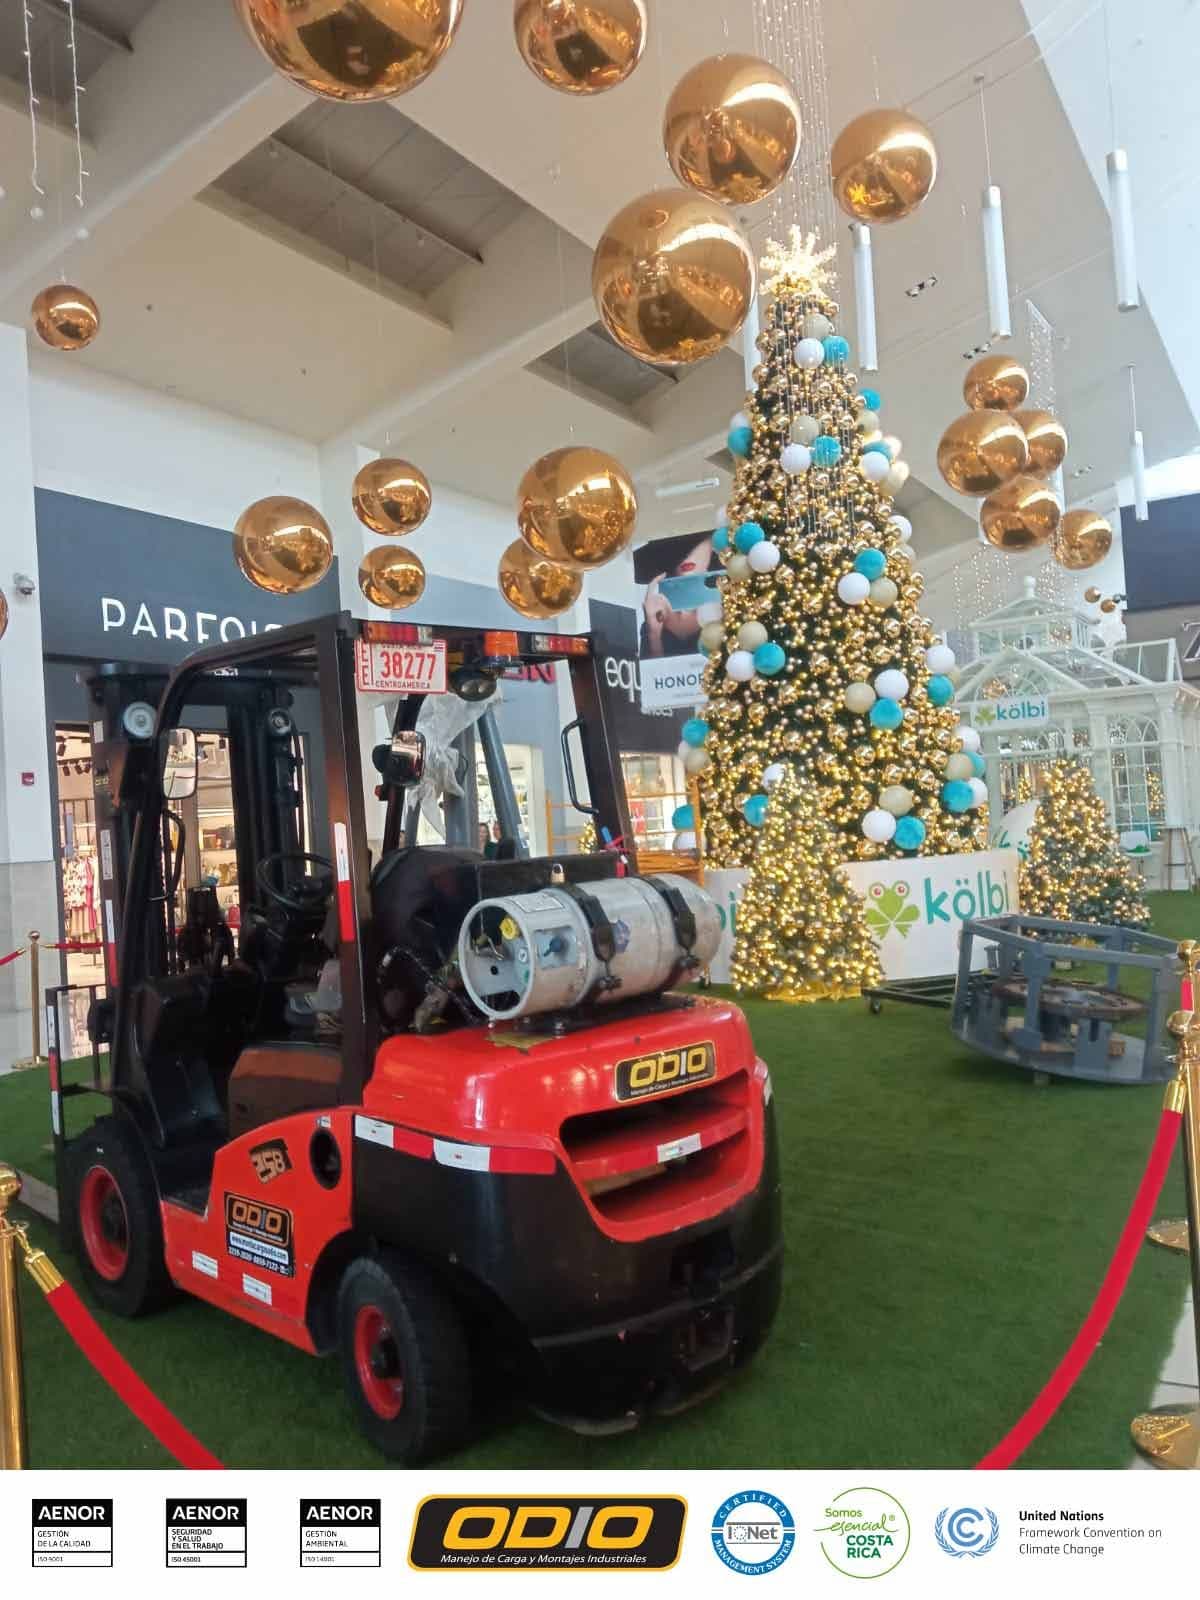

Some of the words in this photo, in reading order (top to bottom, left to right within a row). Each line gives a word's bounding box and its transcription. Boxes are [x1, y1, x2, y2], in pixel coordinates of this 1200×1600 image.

[101, 597, 283, 643] PARFO
[380, 650, 437, 681] 38277
[375, 680, 431, 689] CENTROAMERICA
[995, 701, 1046, 721] kölbi
[923, 869, 1010, 925] kölbi
[629, 1047, 707, 1089] ODIO
[232, 1200, 283, 1234] ODIO
